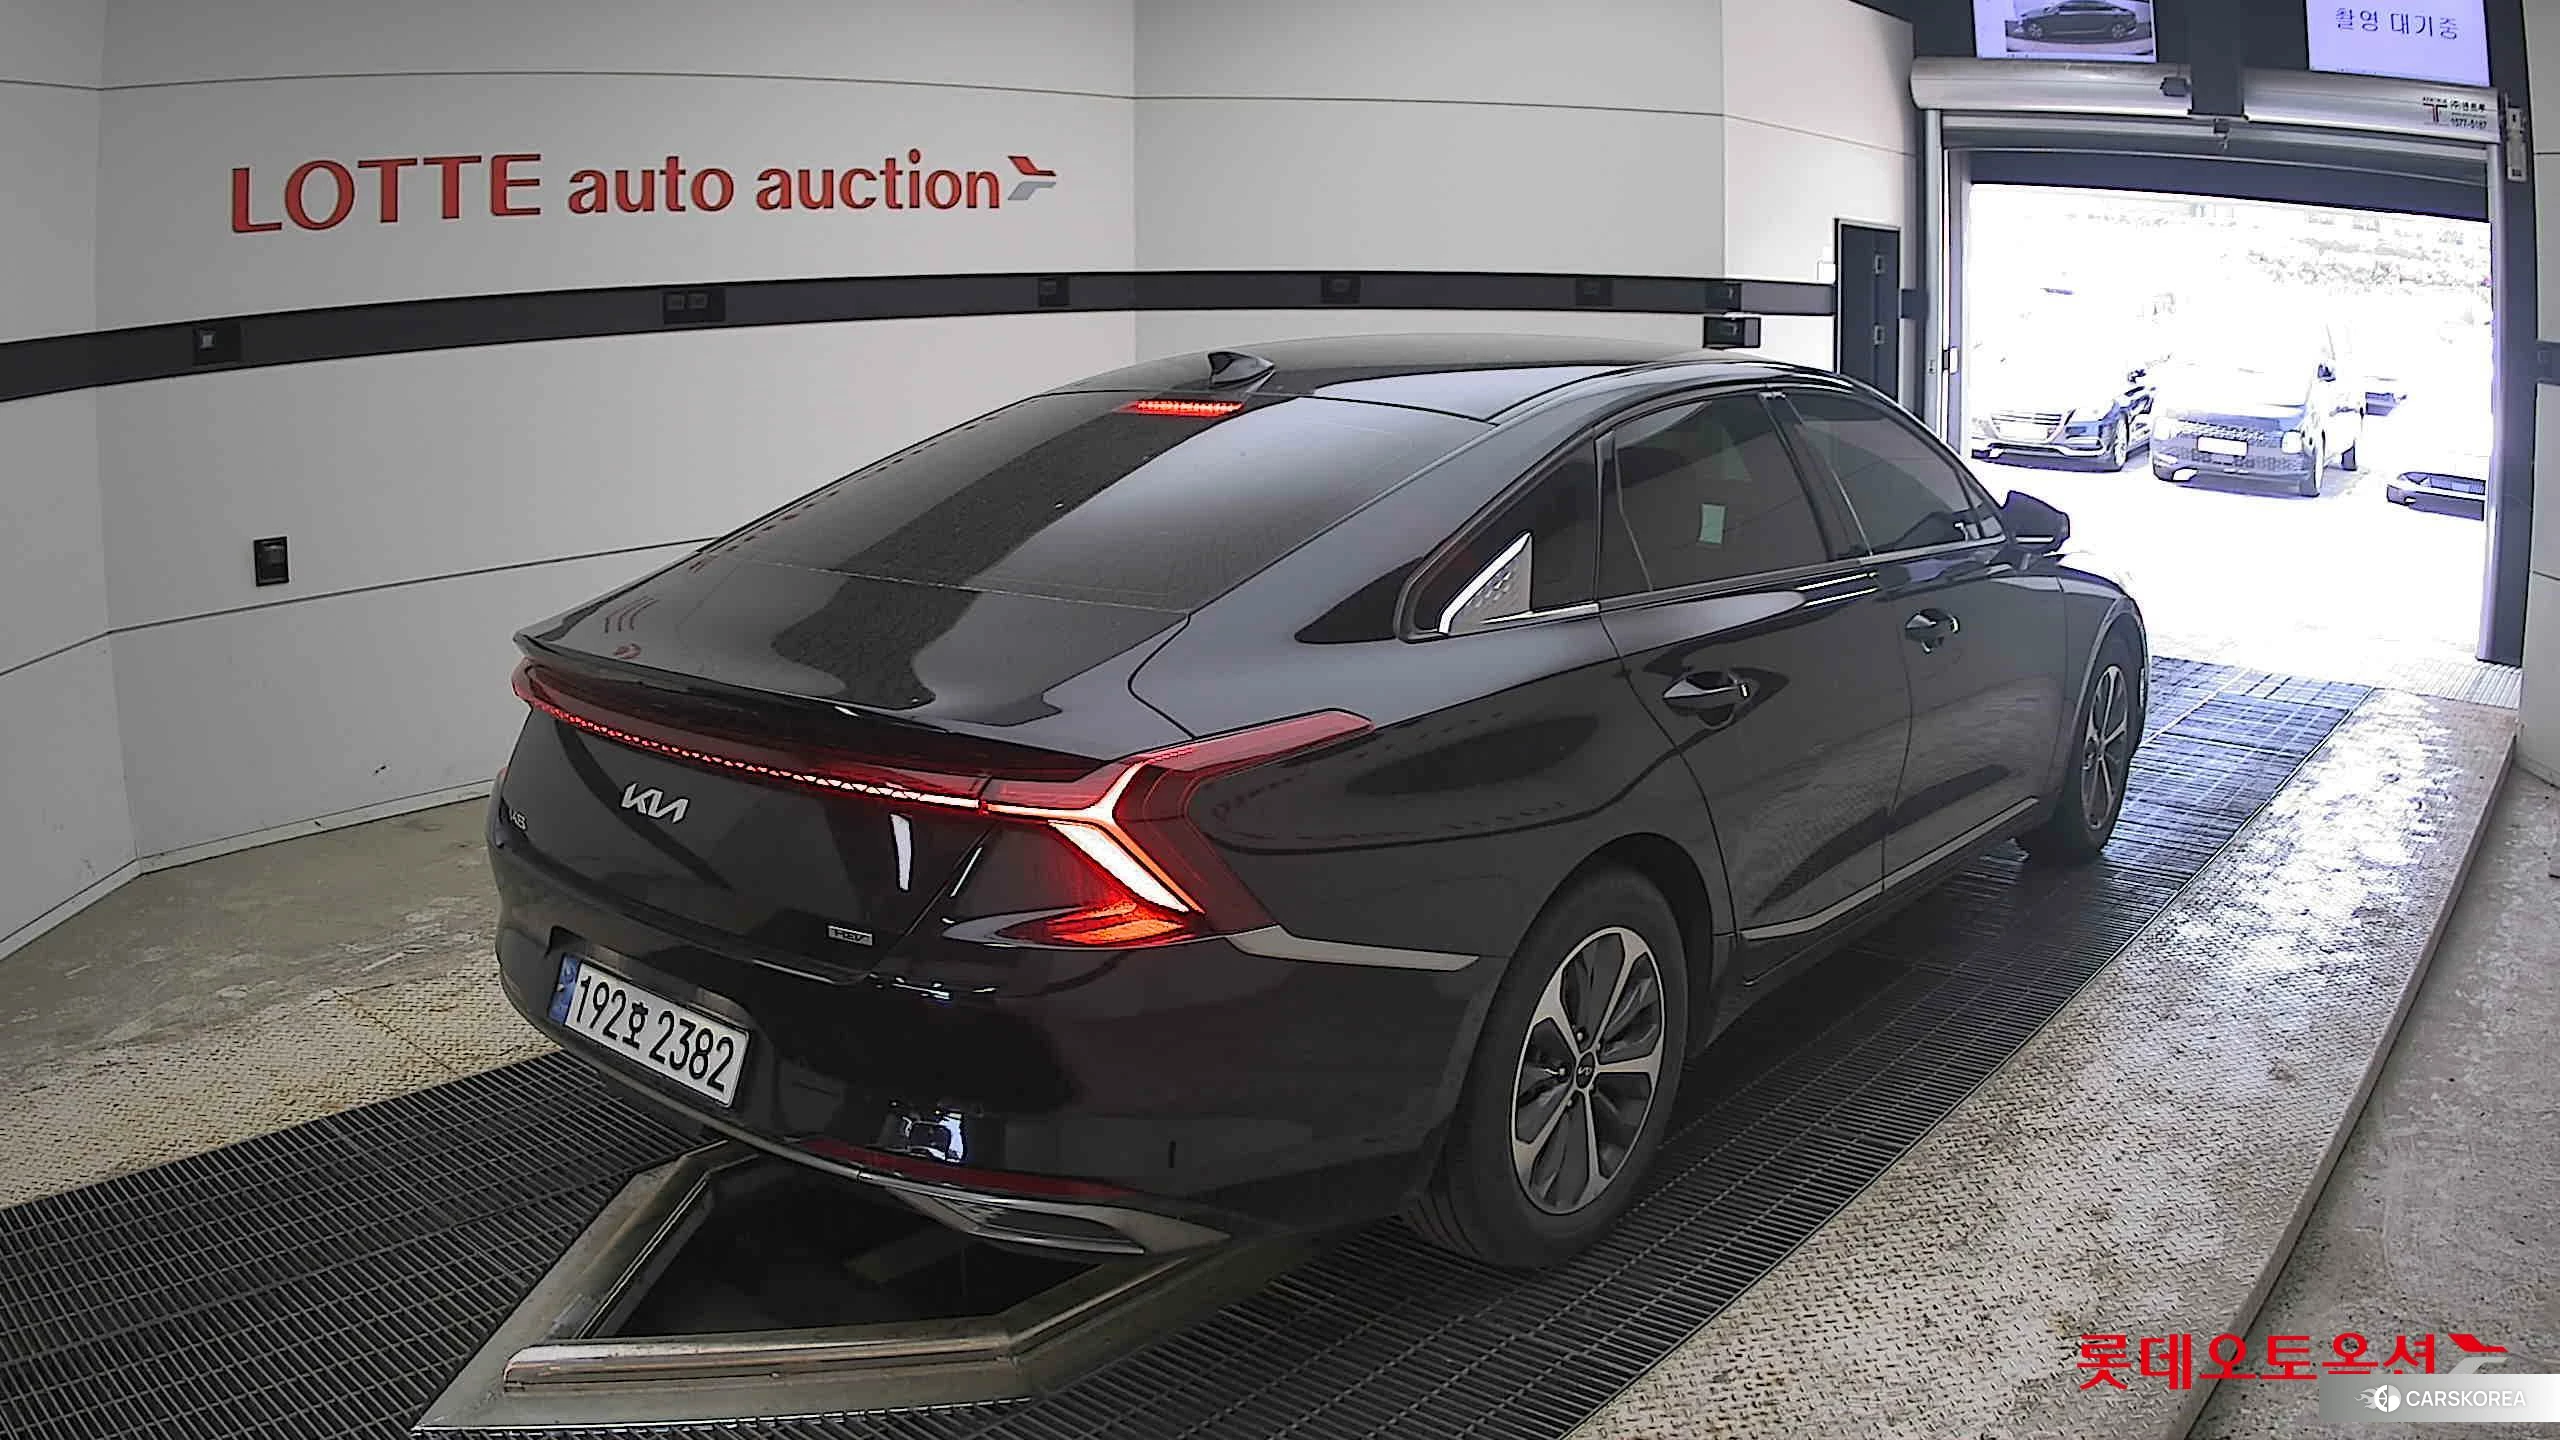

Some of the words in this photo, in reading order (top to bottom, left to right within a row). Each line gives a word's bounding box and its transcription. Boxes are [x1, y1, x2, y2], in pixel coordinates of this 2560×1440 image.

[2389, 13, 2458, 40] 대기중
[231, 153, 541, 233] LOTTE
[567, 155, 734, 214] auto
[756, 148, 1000, 210] auction
[620, 783, 689, 824] KIA
[649, 1010, 734, 1093] 2382
